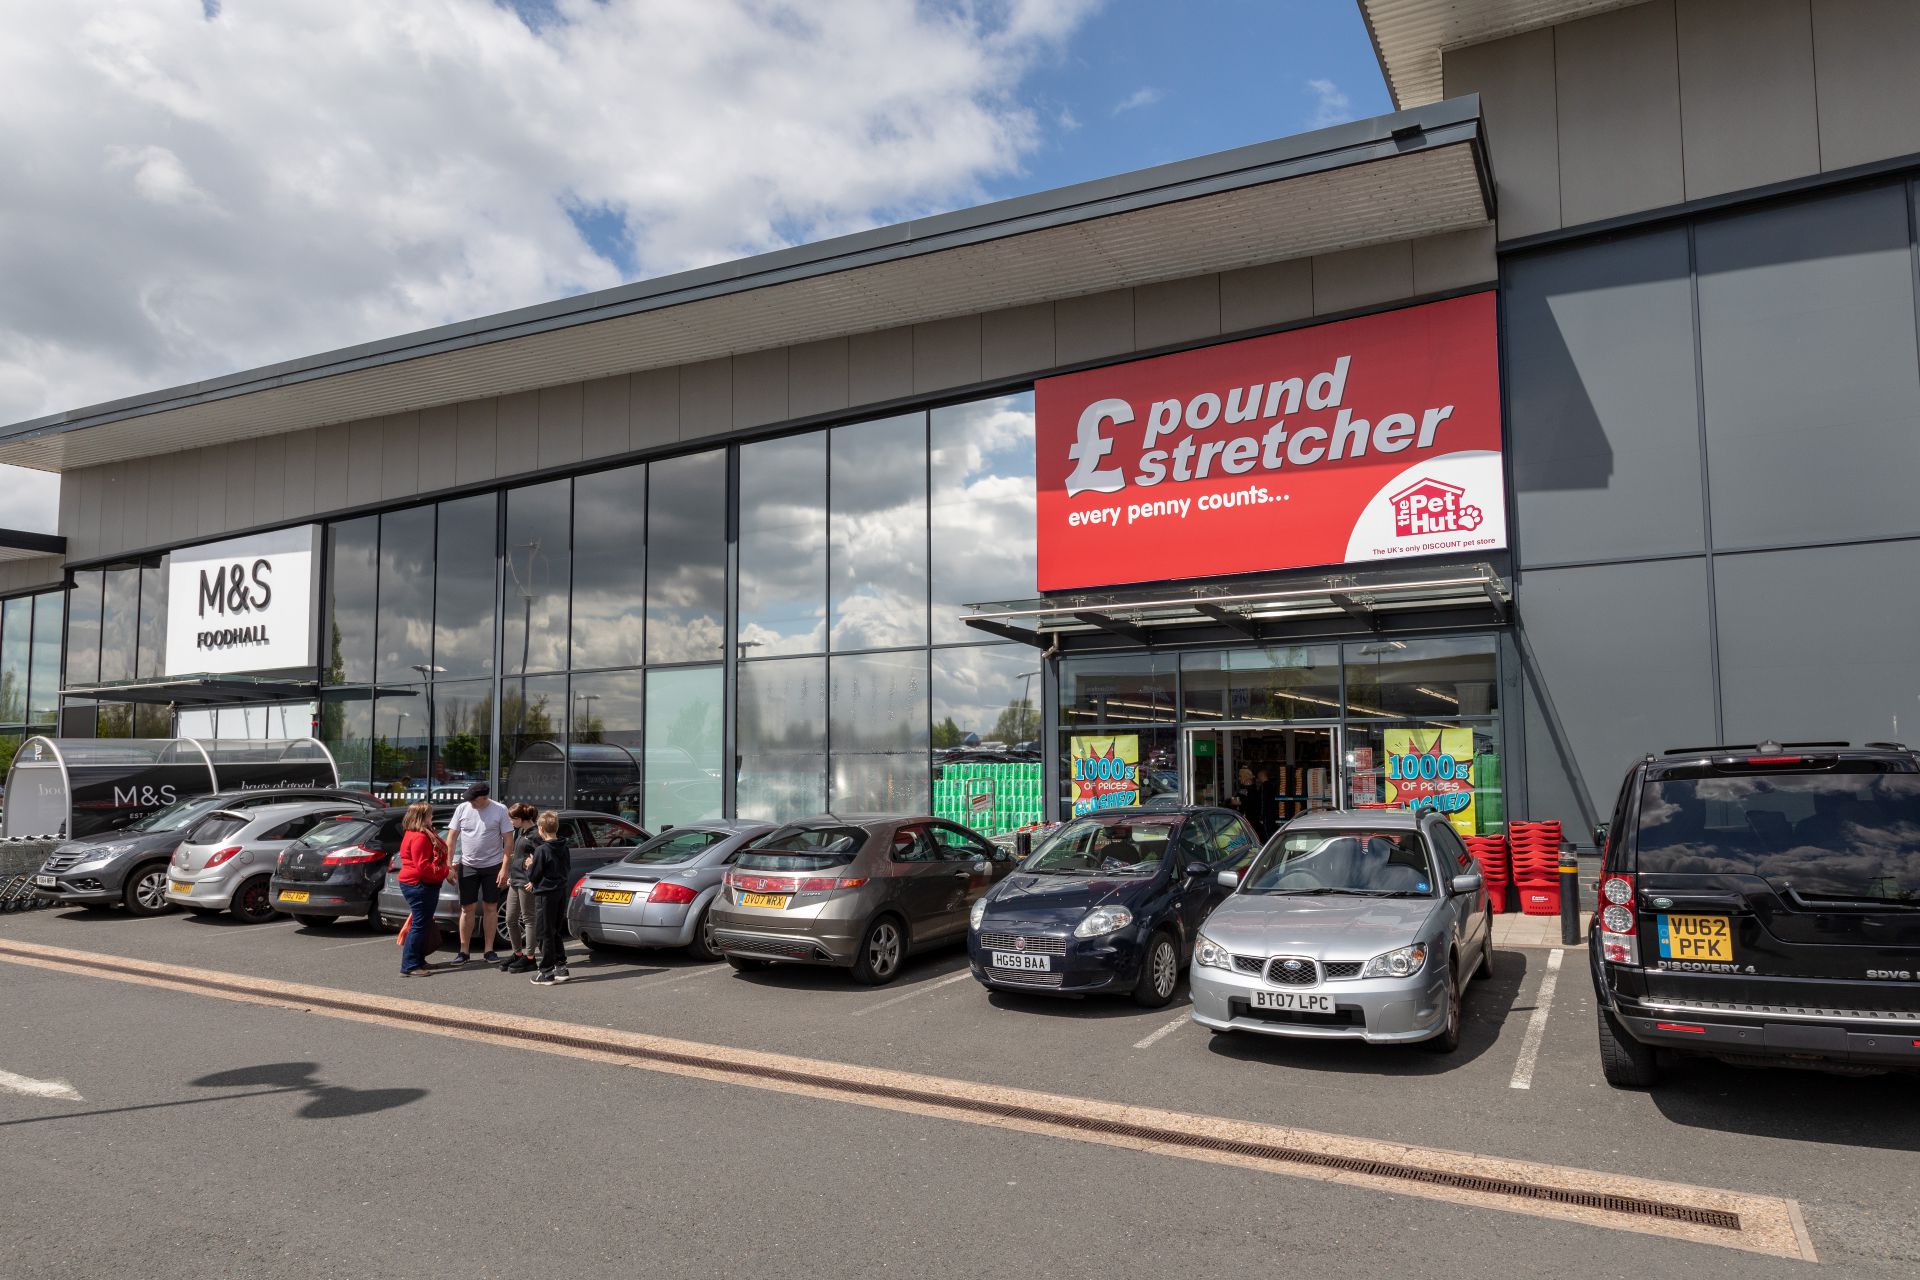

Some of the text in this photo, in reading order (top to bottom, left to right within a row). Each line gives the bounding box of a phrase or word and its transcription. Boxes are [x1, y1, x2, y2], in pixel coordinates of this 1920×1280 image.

[1142, 355, 1352, 450] pound
[1064, 398, 1136, 498] £
[1134, 403, 1455, 487] stretcher
[1068, 484, 1289, 526] every penny counts...
[1397, 500, 1410, 527] the
[1410, 491, 1456, 516] Pet
[1411, 511, 1458, 534] Hut
[1372, 548, 1386, 556] The
[1422, 540, 1461, 551] DISCOUNT
[1462, 540, 1475, 548] pet
[199, 559, 272, 618] M&S
[197, 625, 269, 649] FOODHALL
[1075, 757, 1135, 780] 1000s
[1389, 754, 1469, 780] 1000s
[113, 785, 177, 807] M&S
[1083, 782, 1128, 790] OF PRICES
[1401, 782, 1460, 791] OF PRICES
[766, 896, 783, 906] WRX
[1671, 917, 1727, 937] VU62
[1679, 938, 1722, 957] PFK
[996, 954, 1045, 969] HG59 BAA
[1657, 960, 1756, 973] DISCOVERY 4
[1866, 969, 1911, 979] SDV6
[1256, 992, 1329, 1010] BT07 LPC
